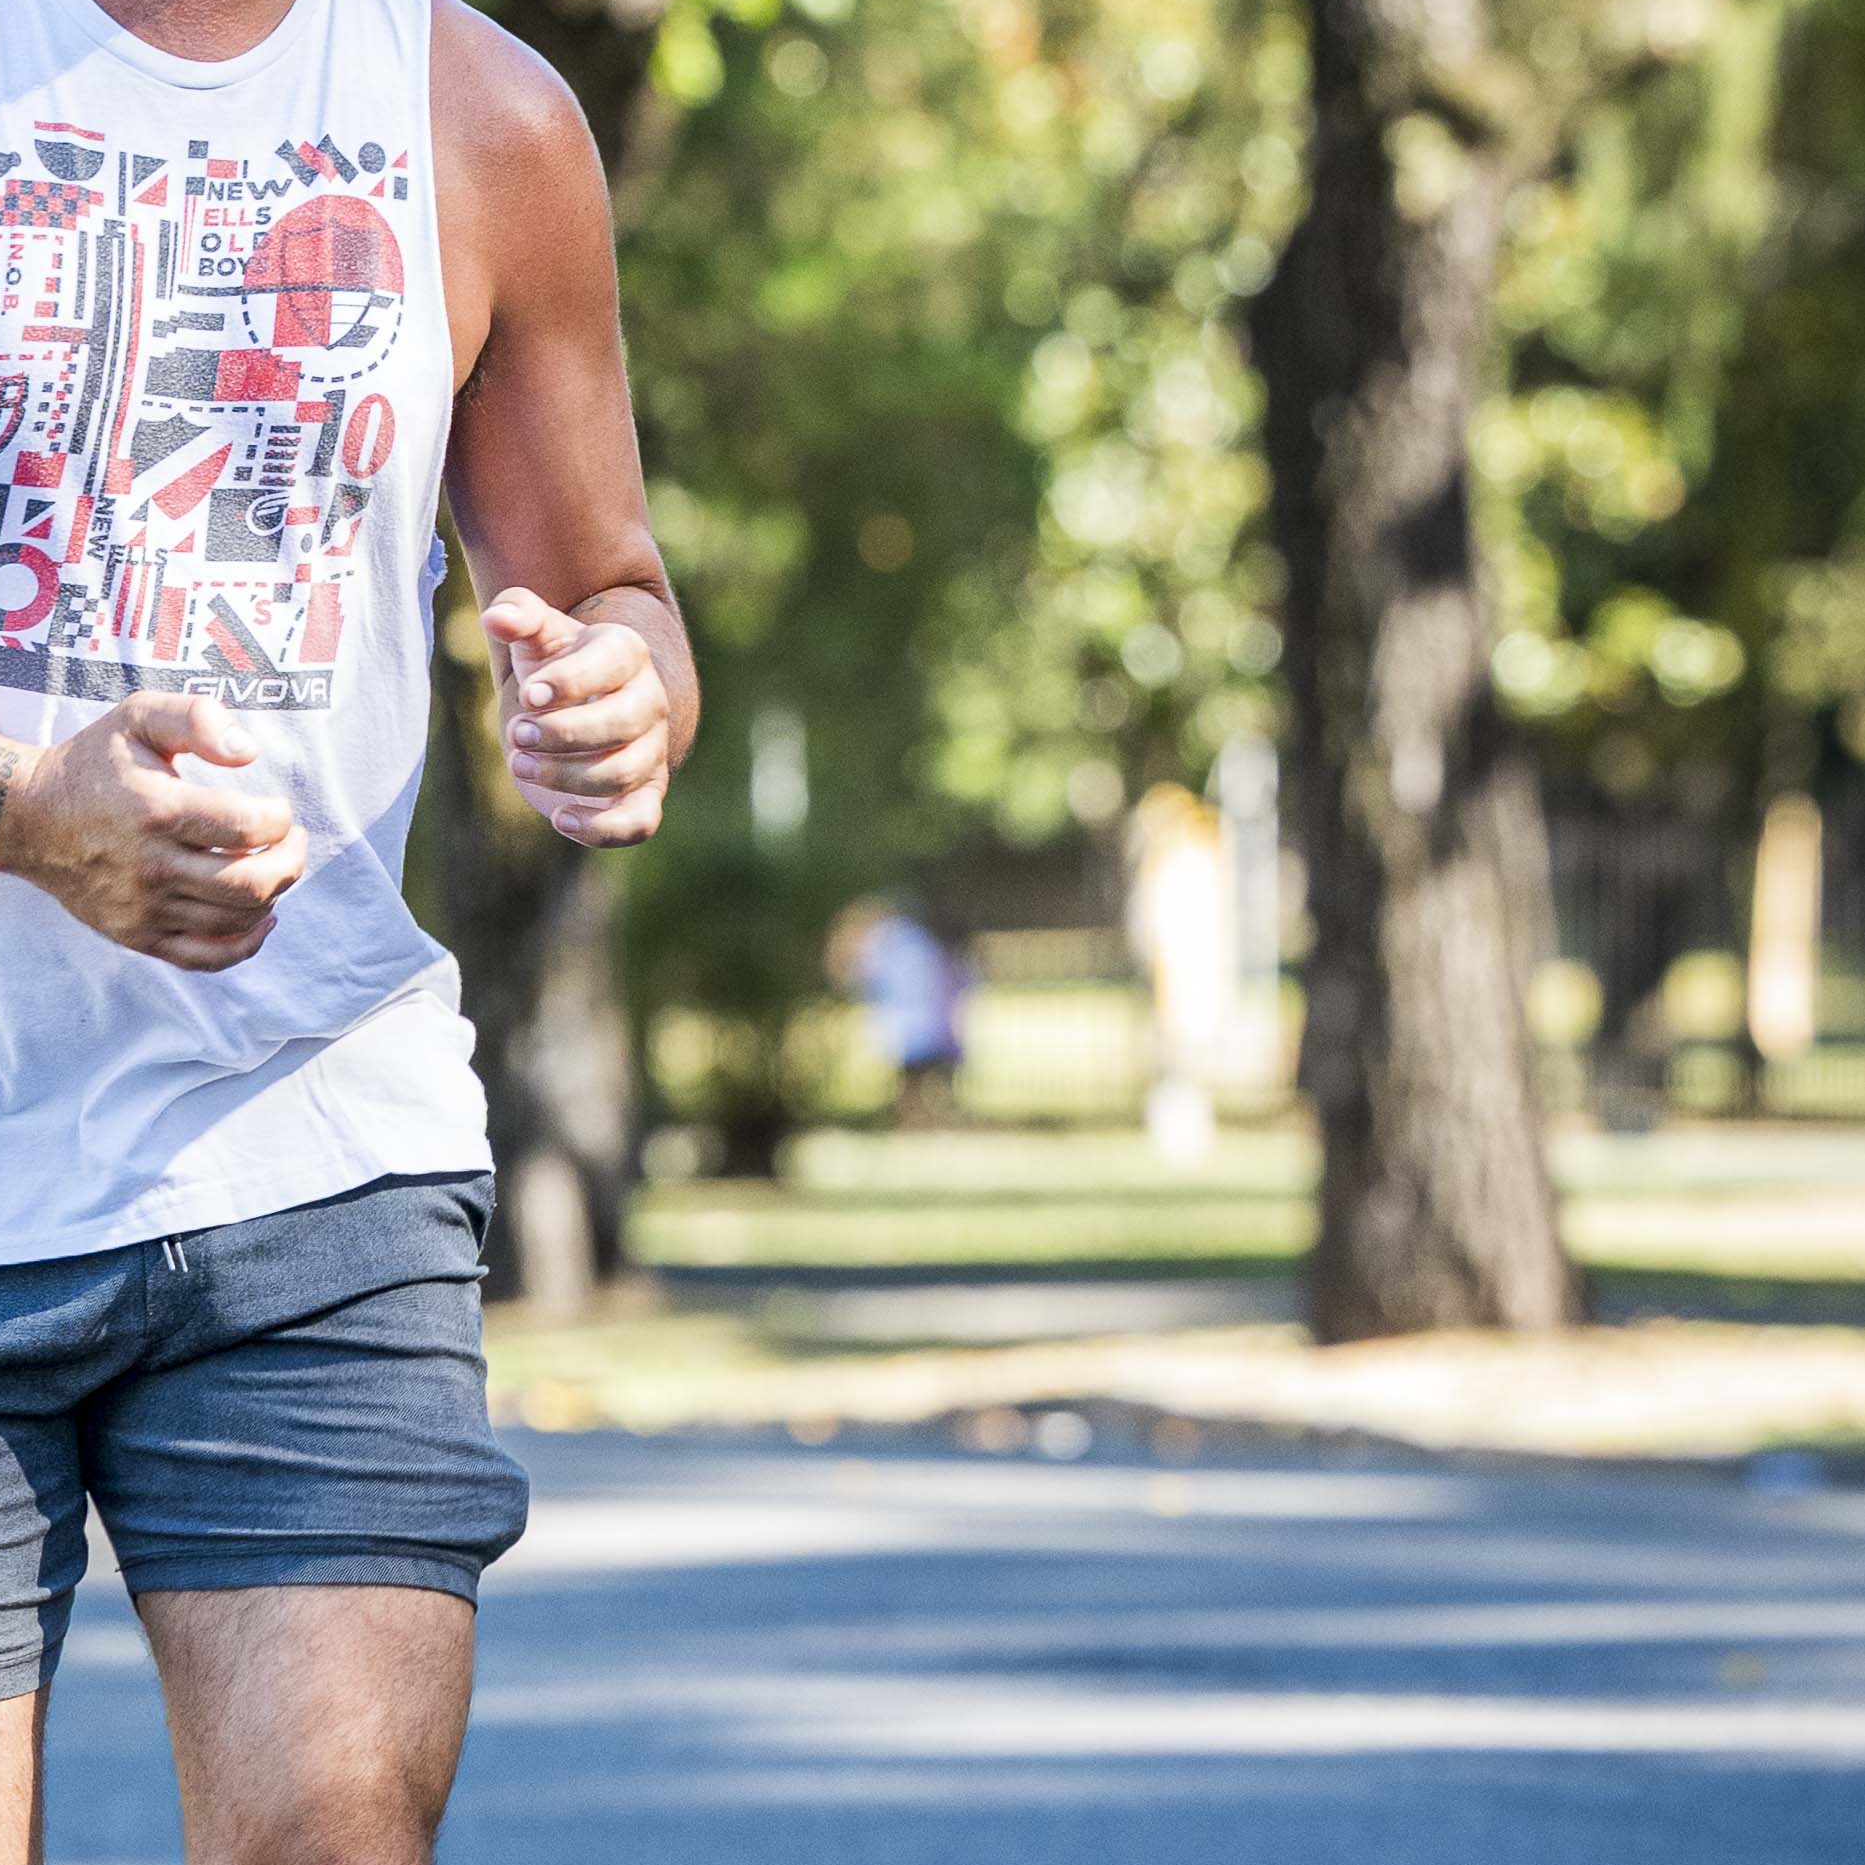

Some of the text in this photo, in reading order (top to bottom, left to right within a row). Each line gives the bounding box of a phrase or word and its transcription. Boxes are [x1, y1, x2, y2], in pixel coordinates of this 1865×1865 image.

[207, 178, 293, 201] NEW
[203, 206, 272, 227] ELLS
[304, 389, 396, 480] 10
[183, 676, 328, 704] GIVOVA
